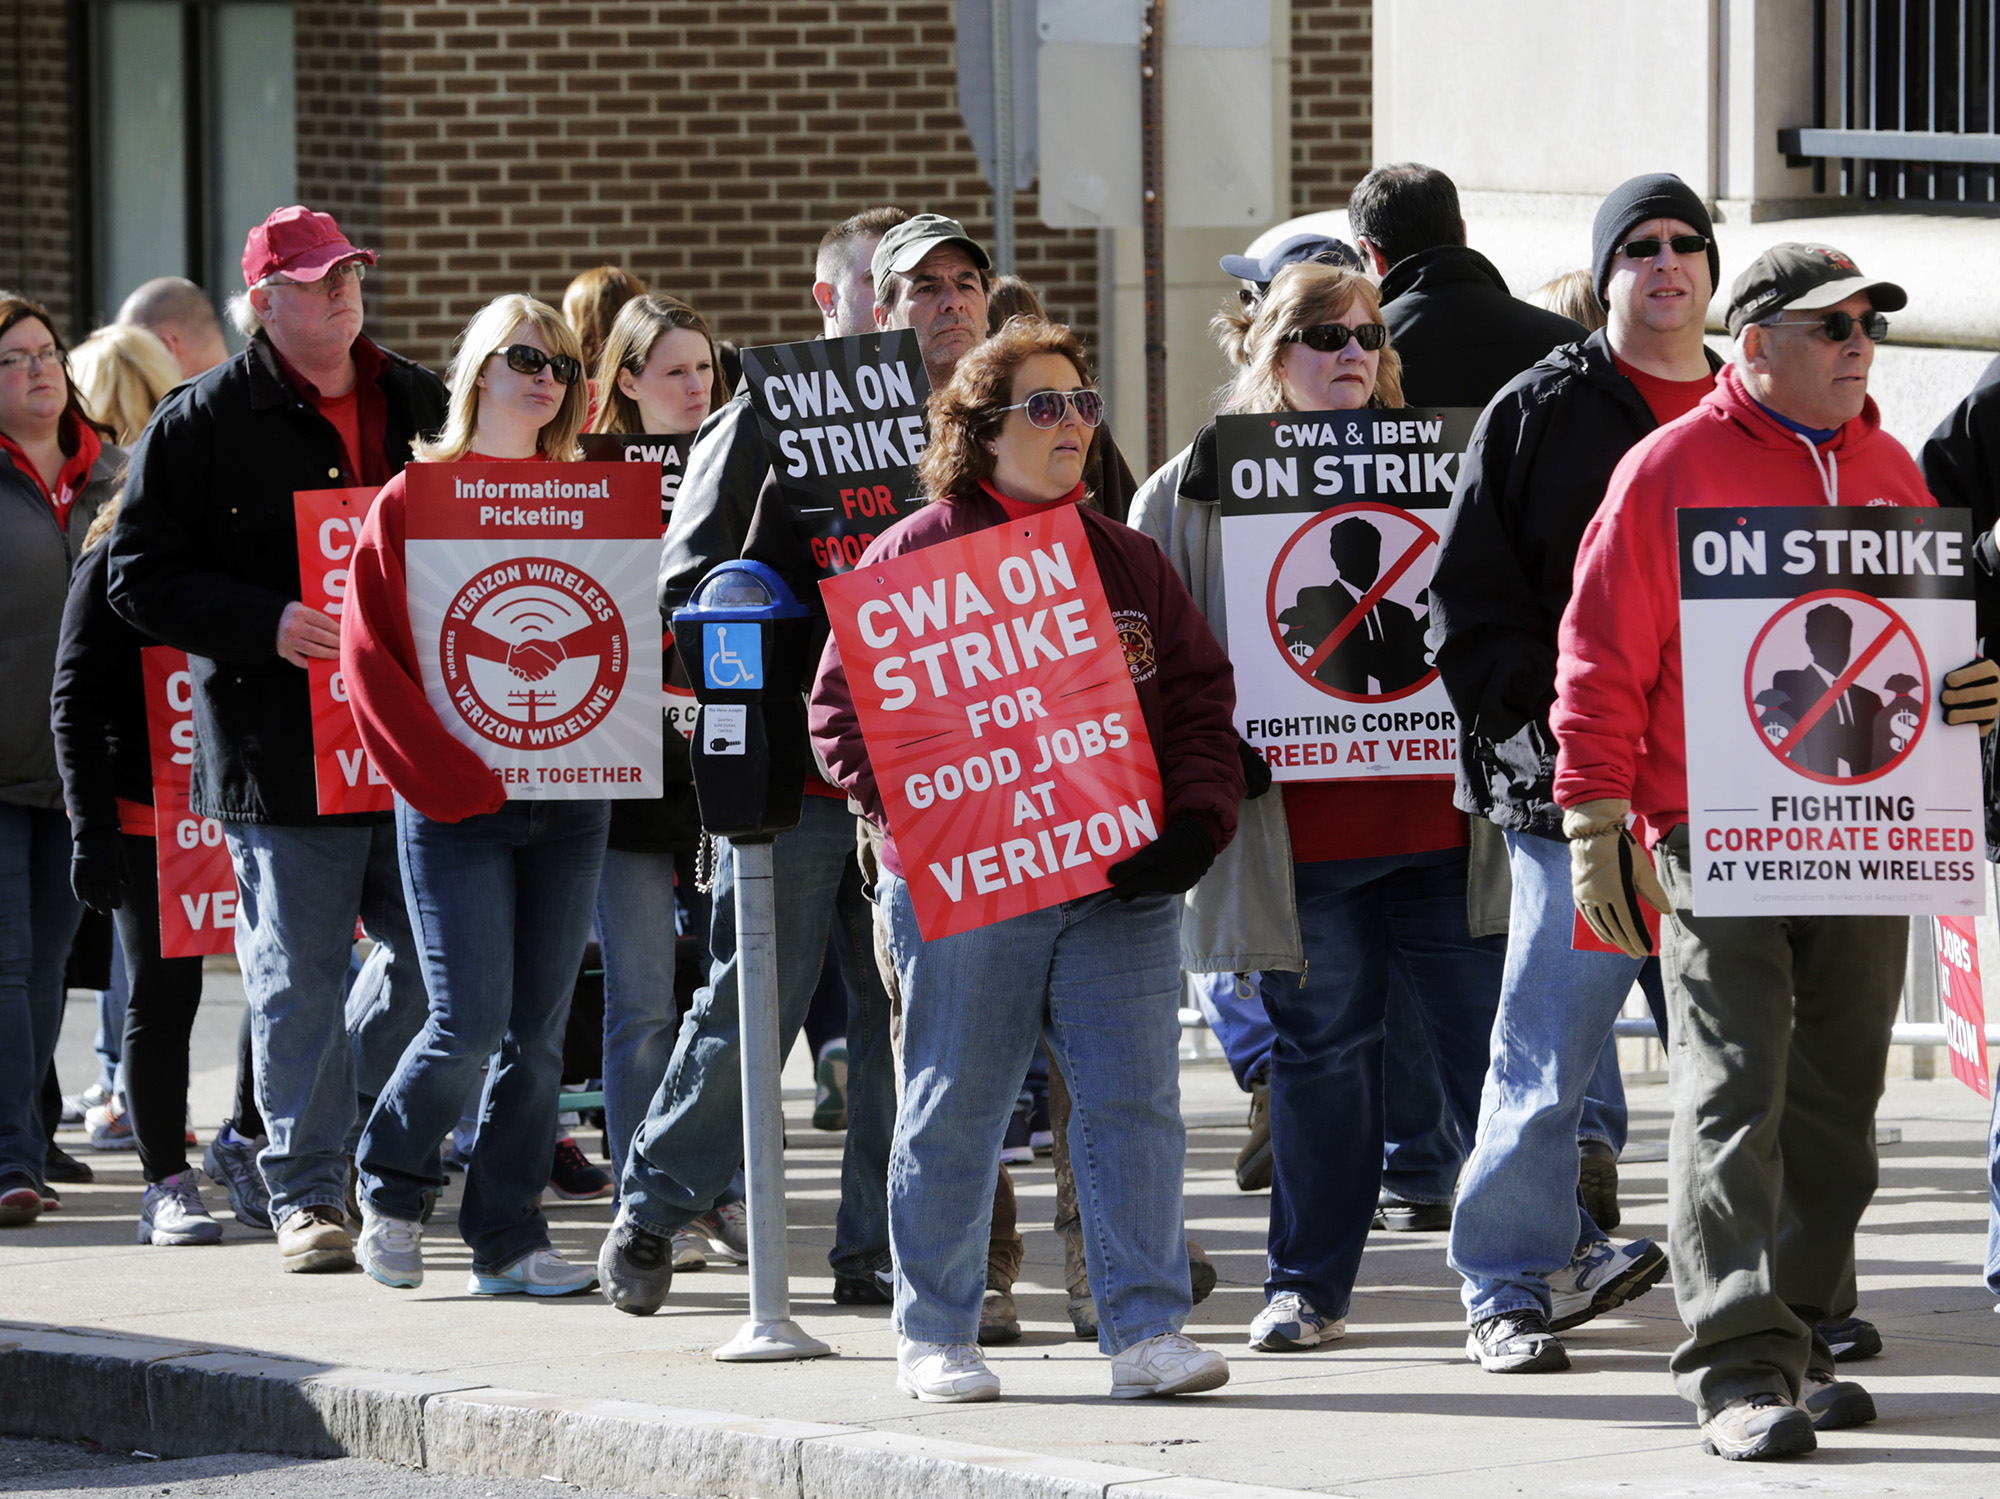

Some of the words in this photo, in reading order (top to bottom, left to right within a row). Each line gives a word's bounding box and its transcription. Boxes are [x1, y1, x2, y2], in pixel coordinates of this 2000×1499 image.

[763, 370, 855, 421] CWA
[855, 361, 916, 411] ON
[624, 444, 681, 466] CWA
[778, 415, 927, 478] STRIKE
[1274, 423, 1338, 448] CWA
[1345, 422, 1364, 446] &
[1372, 420, 1443, 445] IBEW
[455, 478, 610, 499] Informational
[1231, 456, 1299, 500] ON
[1312, 452, 1469, 496] STRIK
[480, 506, 584, 530] Picketing
[839, 485, 898, 519] FOR
[1692, 530, 1767, 576] ON
[1781, 530, 1965, 576] STRIKE
[450, 564, 522, 621] VERIZON
[526, 563, 615, 622] WIRELESS
[856, 571, 995, 649] CWA
[997, 541, 1078, 605] ON
[446, 630, 458, 680] WORKERS
[611, 634, 622, 673] UNITED
[872, 598, 1098, 712] STRIKE
[1129, 664, 1140, 674] 6
[455, 683, 523, 744] VERIZON
[528, 684, 614, 745] WIRELINE
[965, 686, 1049, 738] FOR
[1246, 714, 1356, 739] FIGHTING
[904, 747, 1023, 810] GOOD
[1033, 712, 1130, 773] JOBS
[1346, 740, 1379, 763] AT
[536, 767, 642, 783] TOGETHER
[1013, 780, 1057, 827] AT
[1771, 796, 1915, 822] FIGHTING
[928, 798, 1159, 903] VERIZON
[1705, 827, 1879, 852] CORPORATE
[1888, 827, 1975, 852] GREED
[1706, 861, 1737, 882] AT
[1744, 860, 1852, 881] VERIZON
[1858, 860, 1976, 882] WIRELESS
[1942, 925, 1972, 974] JOBS
[1941, 962, 1951, 998] AT
